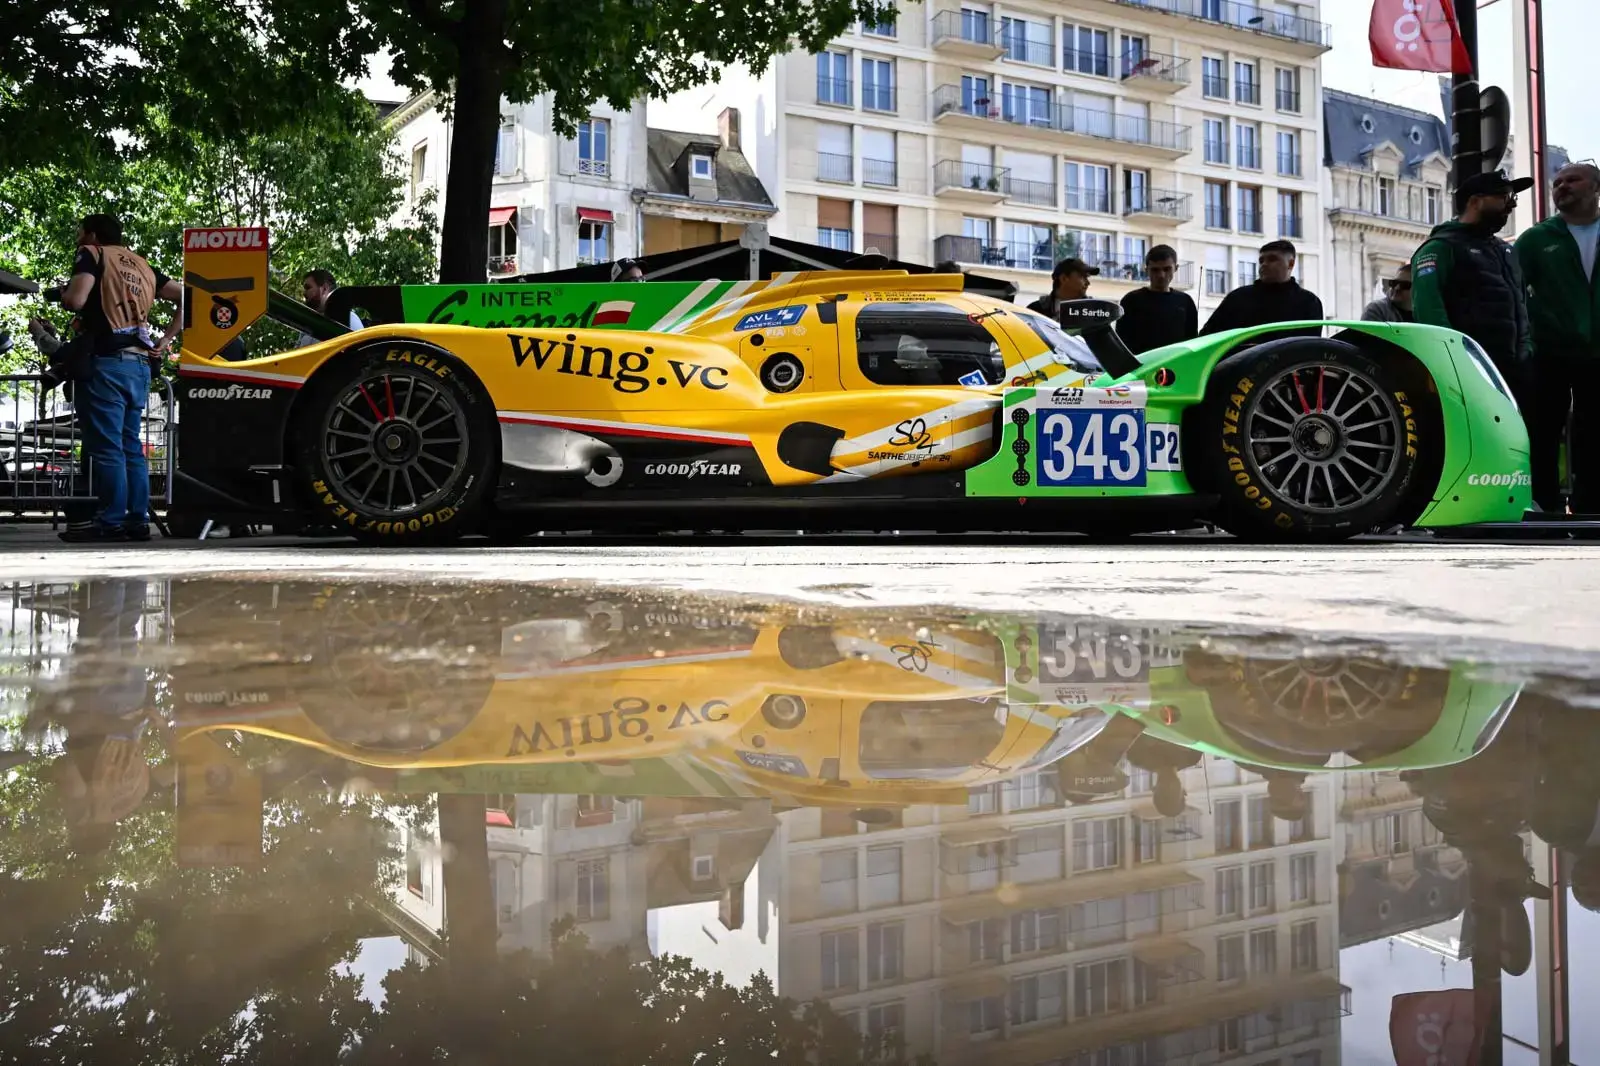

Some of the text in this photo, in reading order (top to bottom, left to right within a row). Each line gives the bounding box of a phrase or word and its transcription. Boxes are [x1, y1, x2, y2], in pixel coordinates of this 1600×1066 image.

[187, 230, 263, 249] MOTUL
[481, 290, 553, 308] INTER
[1069, 307, 1111, 318] La Sarthe
[745, 313, 773, 324] AVL
[386, 349, 452, 379] EAGLE
[506, 333, 730, 393] wing.vc
[188, 383, 273, 401] GOODYEAR
[1394, 391, 1418, 458] EAGLE
[1042, 413, 1141, 482] 343
[1150, 430, 1180, 465] P2
[1222, 376, 1272, 510] GOODYEAR
[644, 459, 742, 479] GOODYEAR
[313, 479, 435, 535] GOODYEAR
